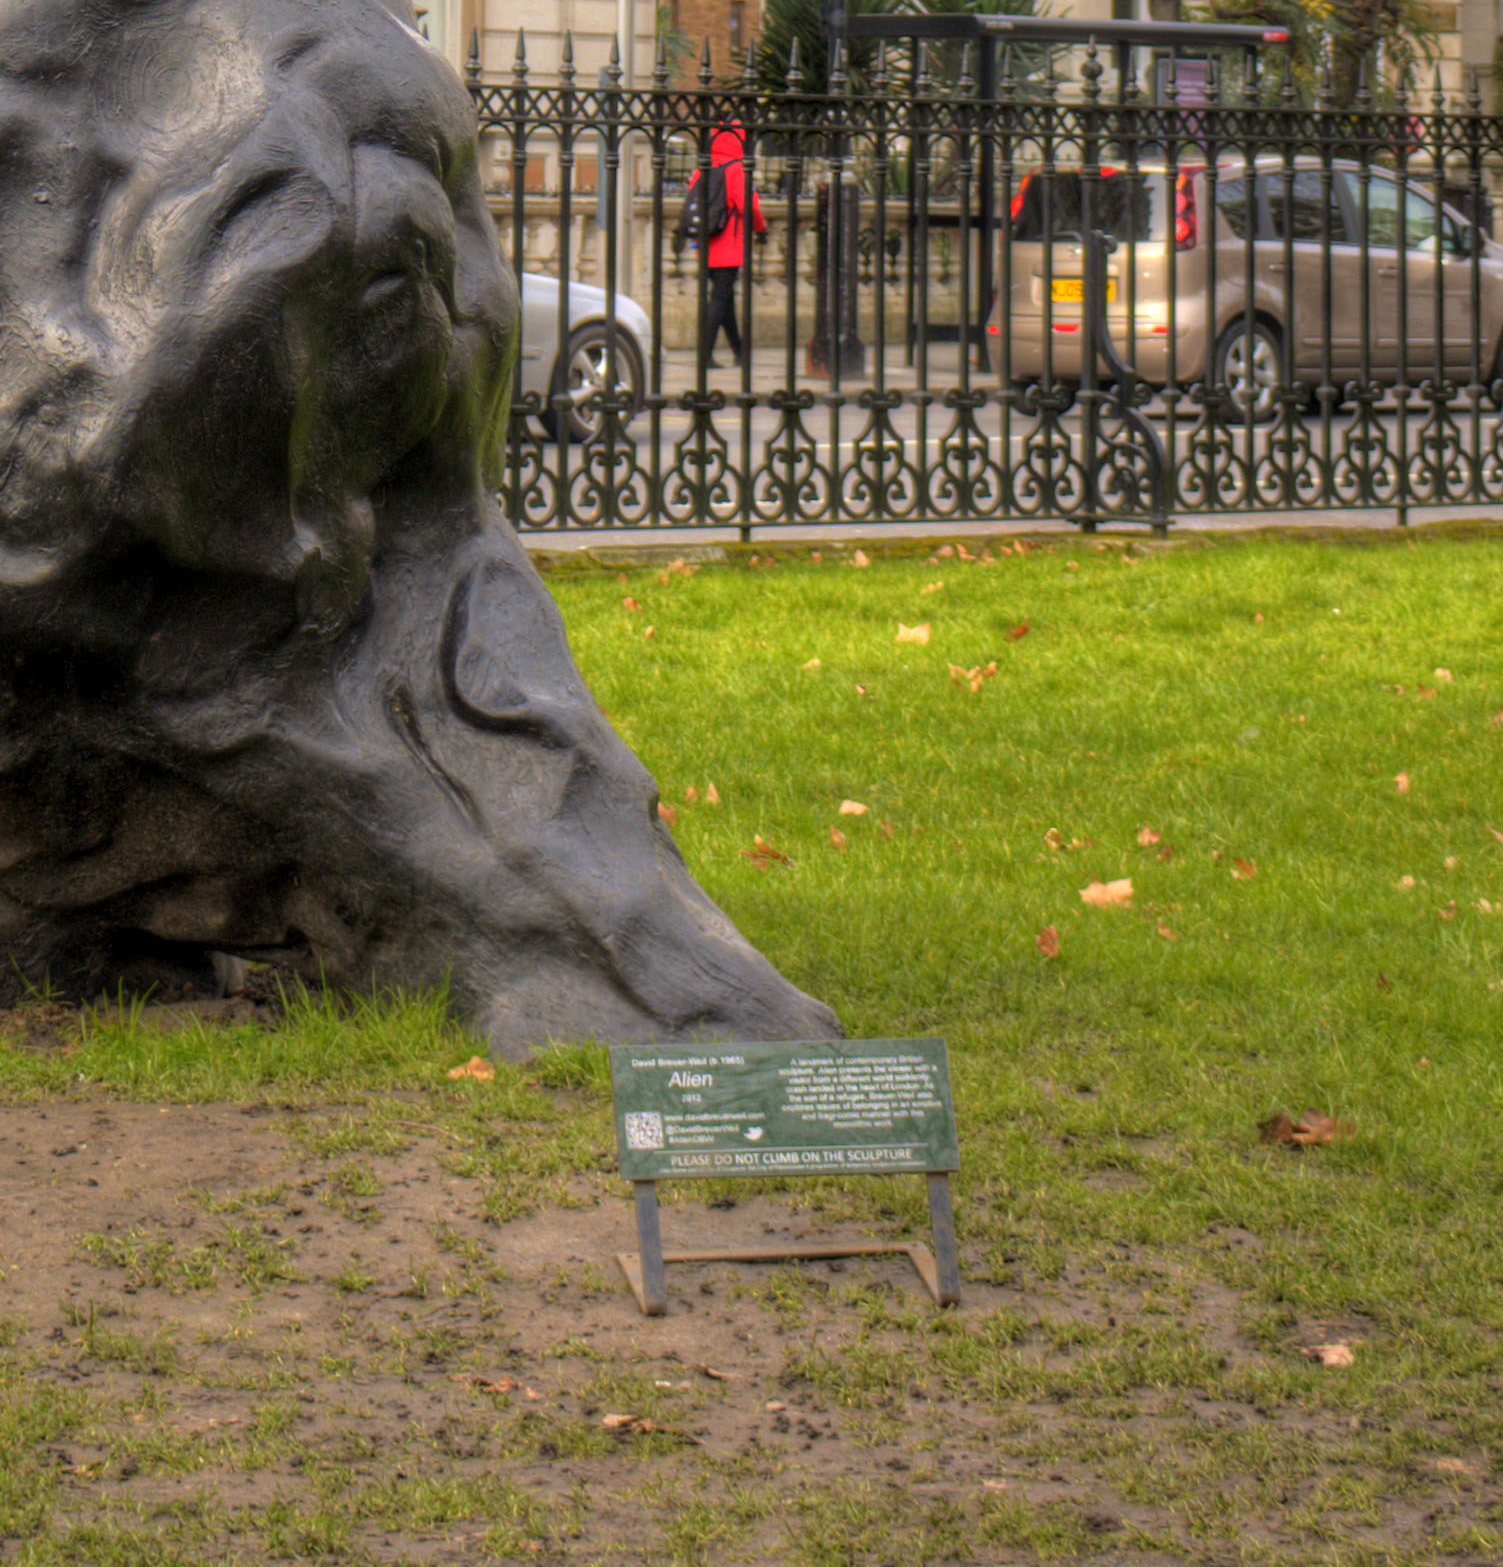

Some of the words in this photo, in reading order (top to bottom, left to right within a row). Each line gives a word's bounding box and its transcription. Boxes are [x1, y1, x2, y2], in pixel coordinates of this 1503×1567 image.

[668, 1070, 713, 1087] Alien
[670, 1153, 711, 1166] PLEASE
[714, 1153, 733, 1165] DO
[735, 1152, 760, 1164] NOT
[762, 1151, 799, 1164] CLIMB
[801, 1151, 820, 1163] ON
[822, 1149, 845, 1162] THE
[847, 1148, 913, 1161] SCULPTURE
